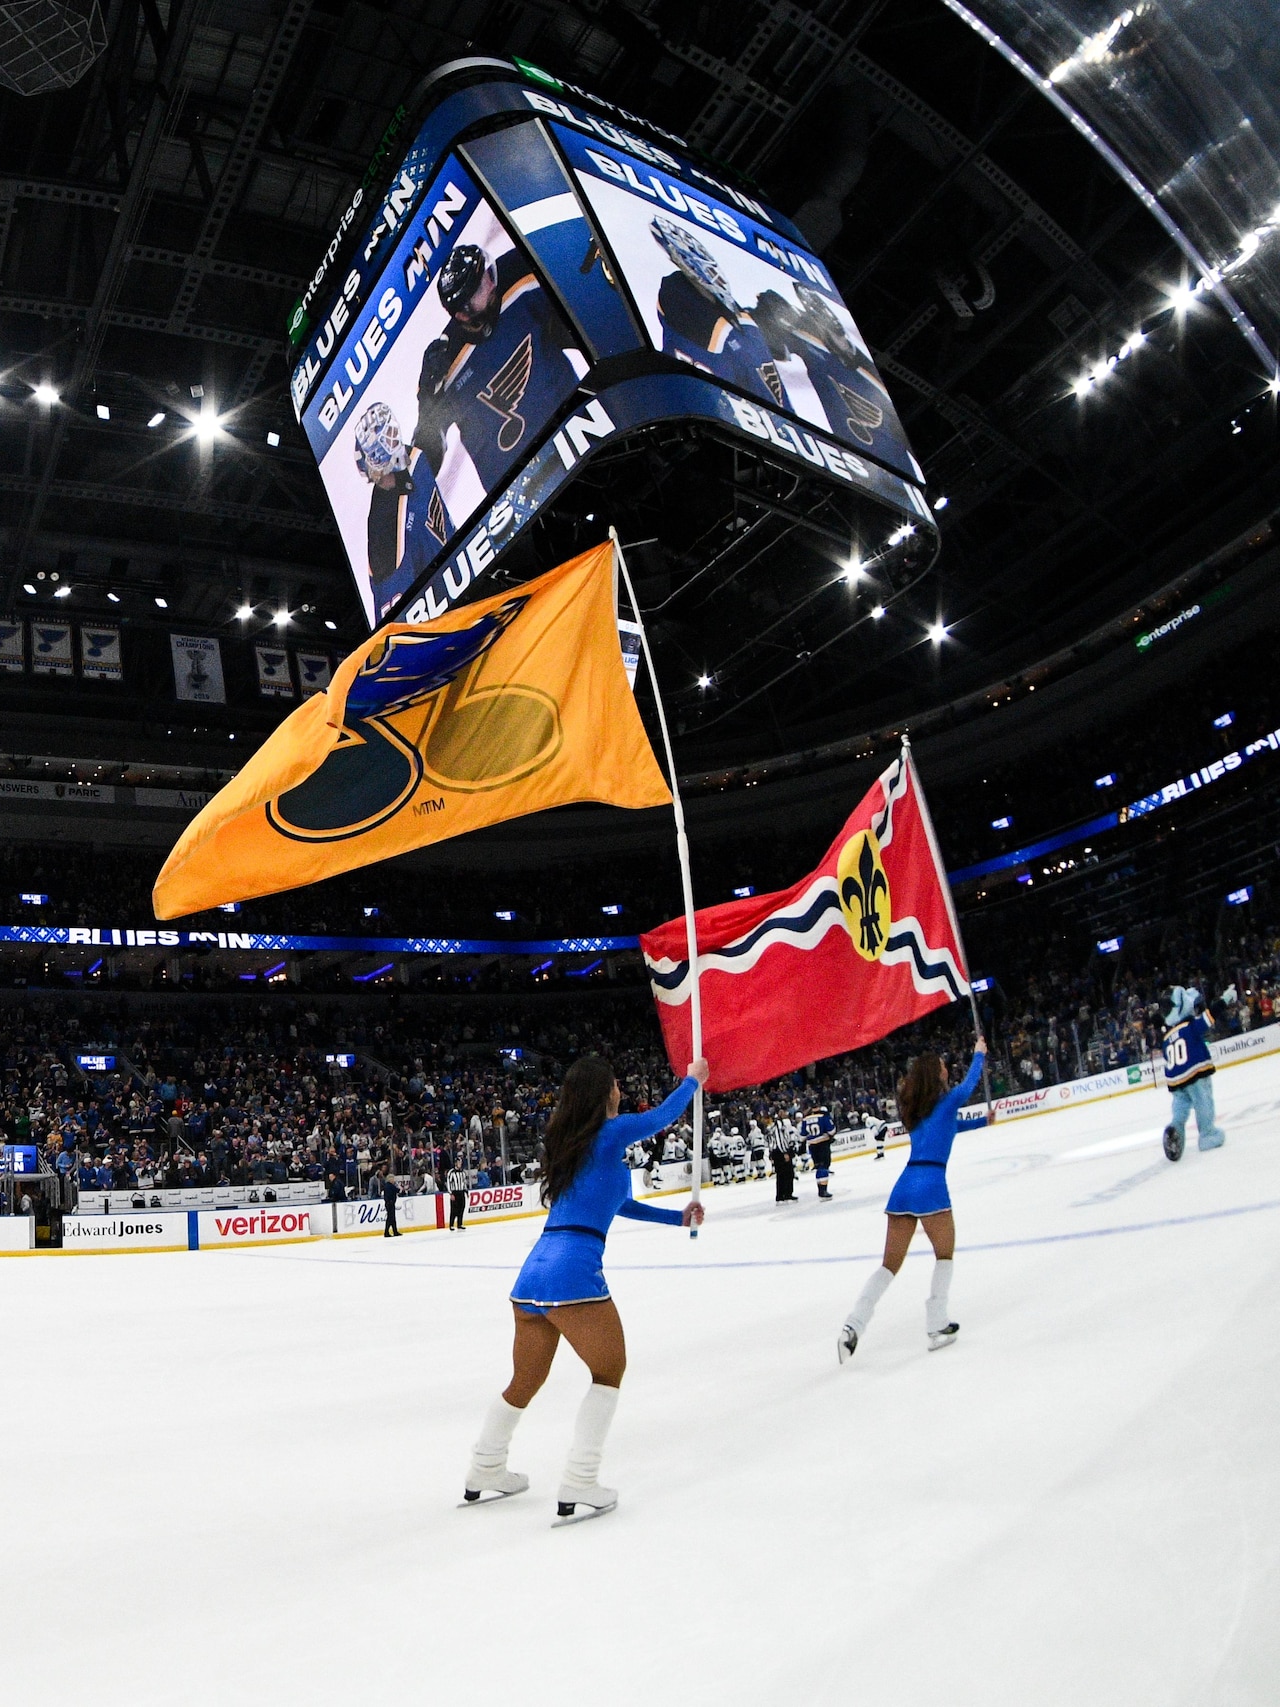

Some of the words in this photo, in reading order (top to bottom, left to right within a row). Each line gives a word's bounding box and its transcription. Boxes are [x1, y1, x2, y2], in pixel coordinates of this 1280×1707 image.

[585, 148, 747, 243] BLUES
[288, 188, 364, 336] enterprise
[292, 268, 361, 410] BLUES
[318, 287, 403, 433] BLUES
[728, 395, 869, 482] BLUES
[405, 501, 514, 625] BLUES
[80, 1055, 106, 1064] BLUE
[1219, 1036, 1266, 1056] HealthCare
[1006, 1103, 1038, 1115] REWARDS
[1072, 1081, 1095, 1096] PNC
[1095, 1074, 1124, 1090] BANK
[469, 1186, 523, 1206] DOBBS
[63, 1221, 116, 1237] Edward
[118, 1221, 163, 1237] Jones
